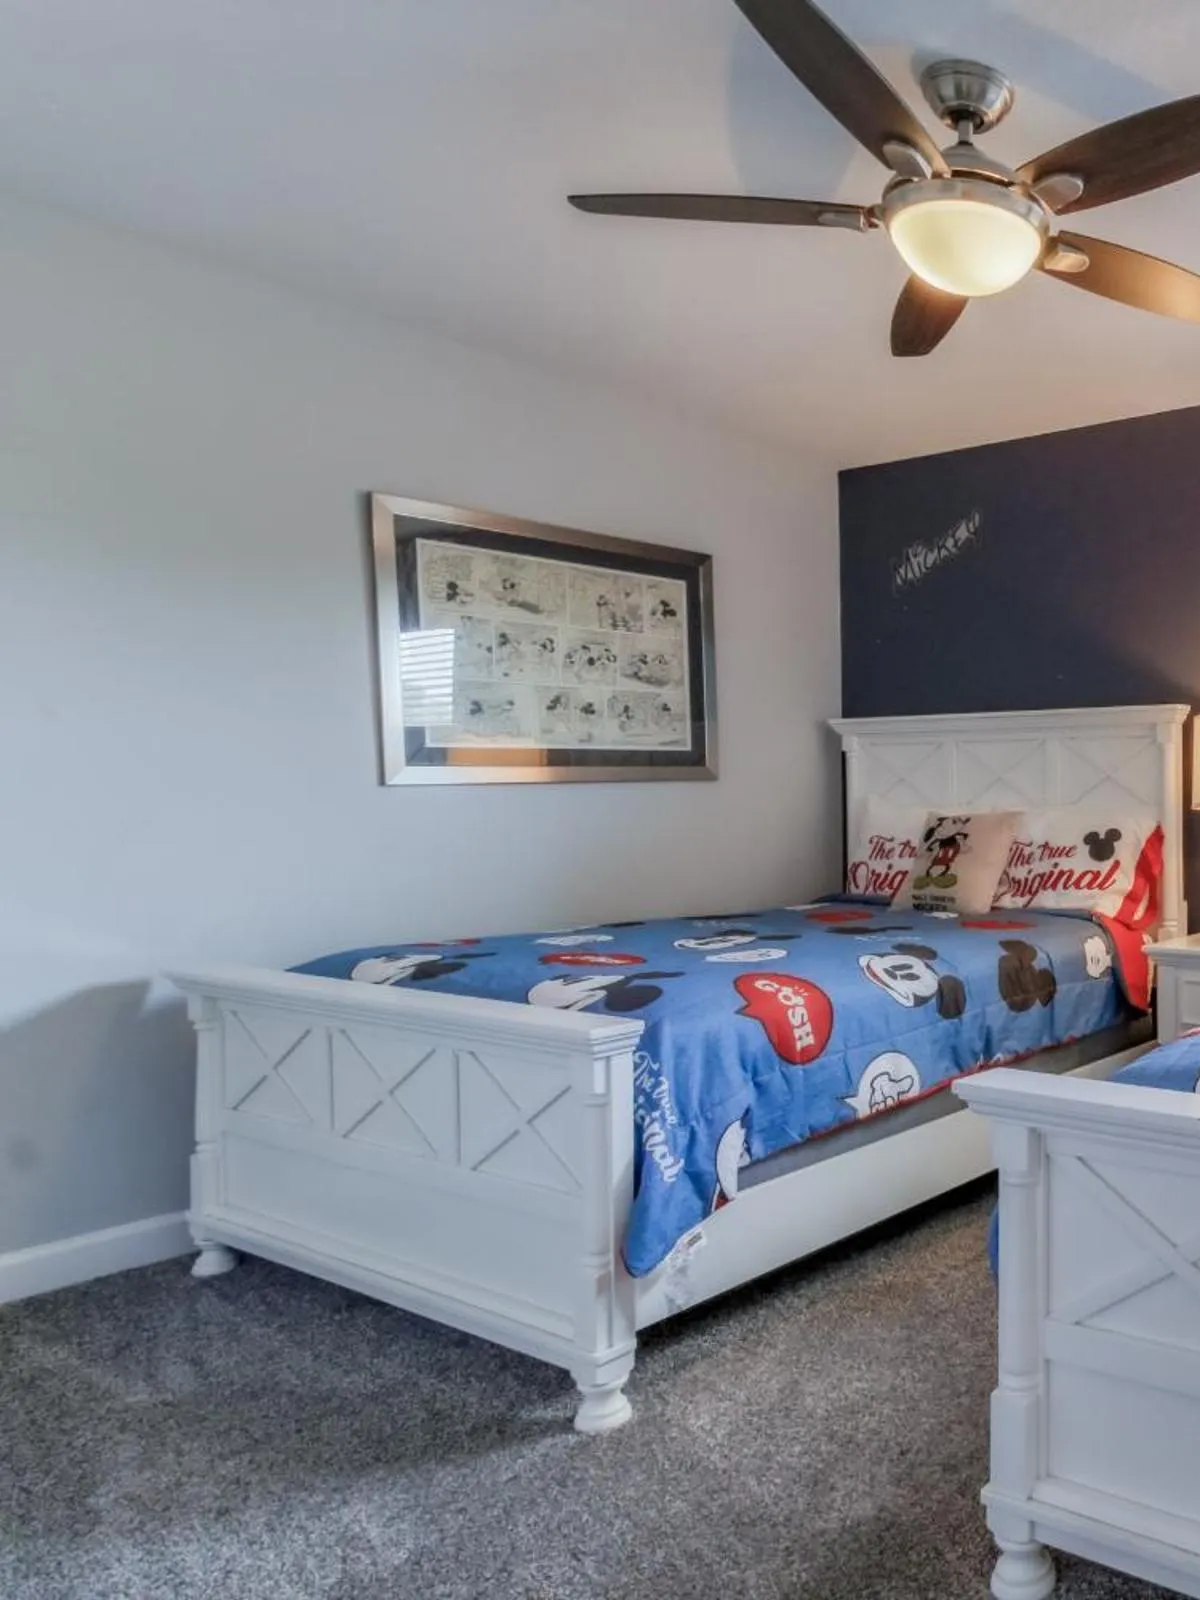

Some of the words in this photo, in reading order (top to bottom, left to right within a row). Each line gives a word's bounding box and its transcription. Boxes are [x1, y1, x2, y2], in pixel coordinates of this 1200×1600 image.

[868, 834, 895, 860] The
[1008, 839, 1034, 868] The
[1037, 841, 1078, 861] true
